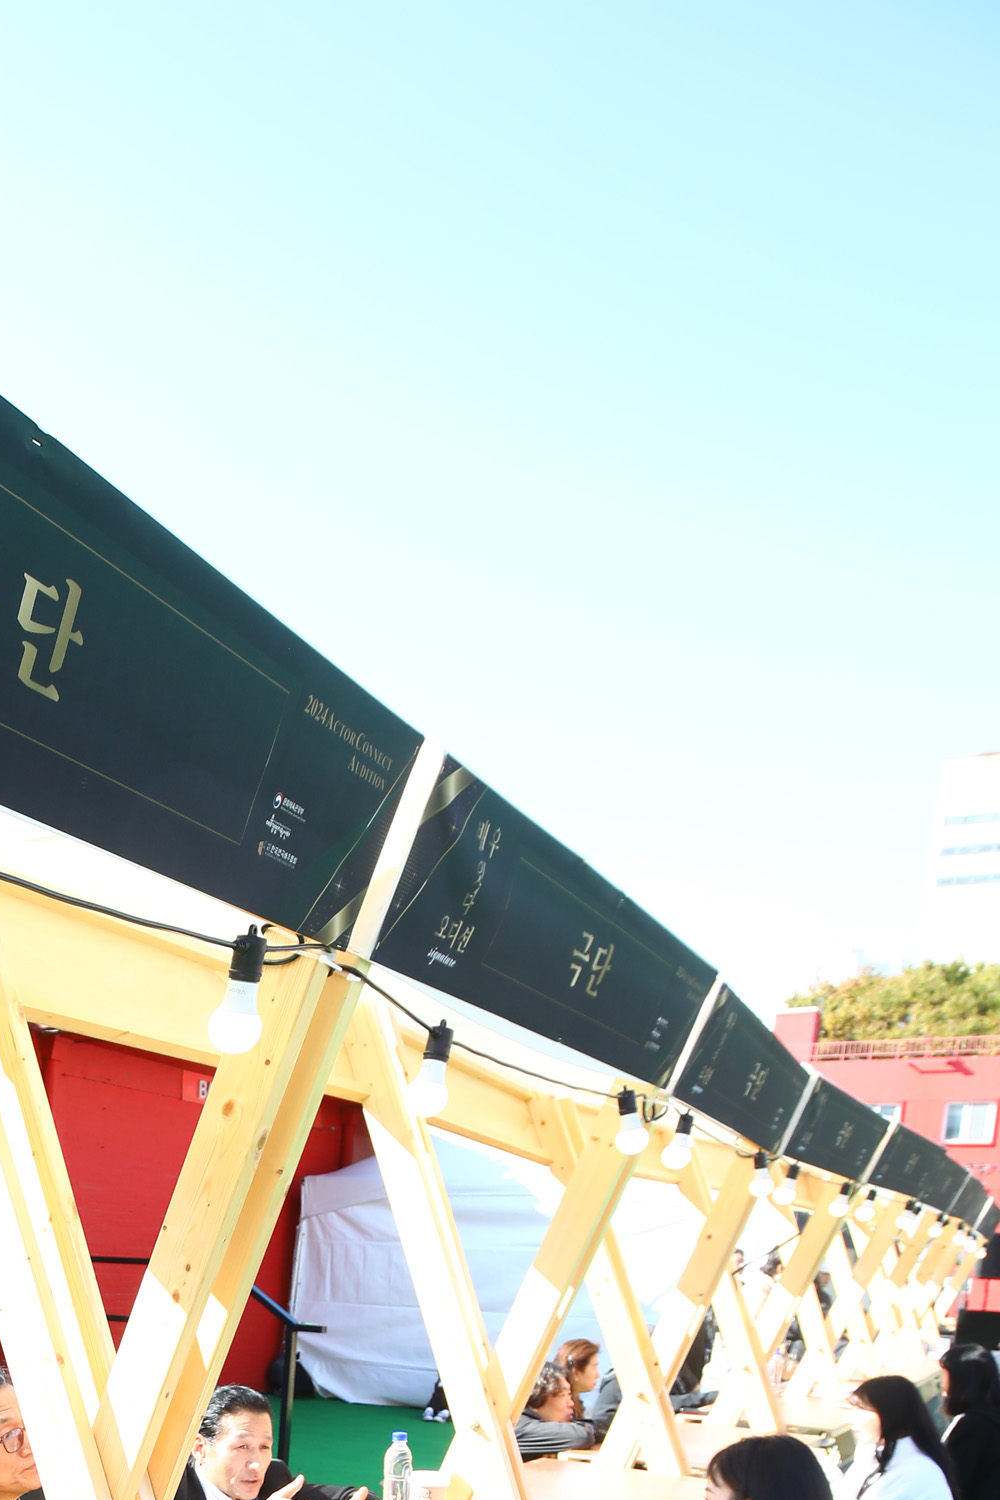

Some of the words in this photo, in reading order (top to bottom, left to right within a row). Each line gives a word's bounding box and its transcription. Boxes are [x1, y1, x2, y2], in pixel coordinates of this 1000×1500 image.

[348, 754, 386, 791] AUDITION
[434, 915, 475, 953] 오디션
[570, 930, 615, 997] 극단
